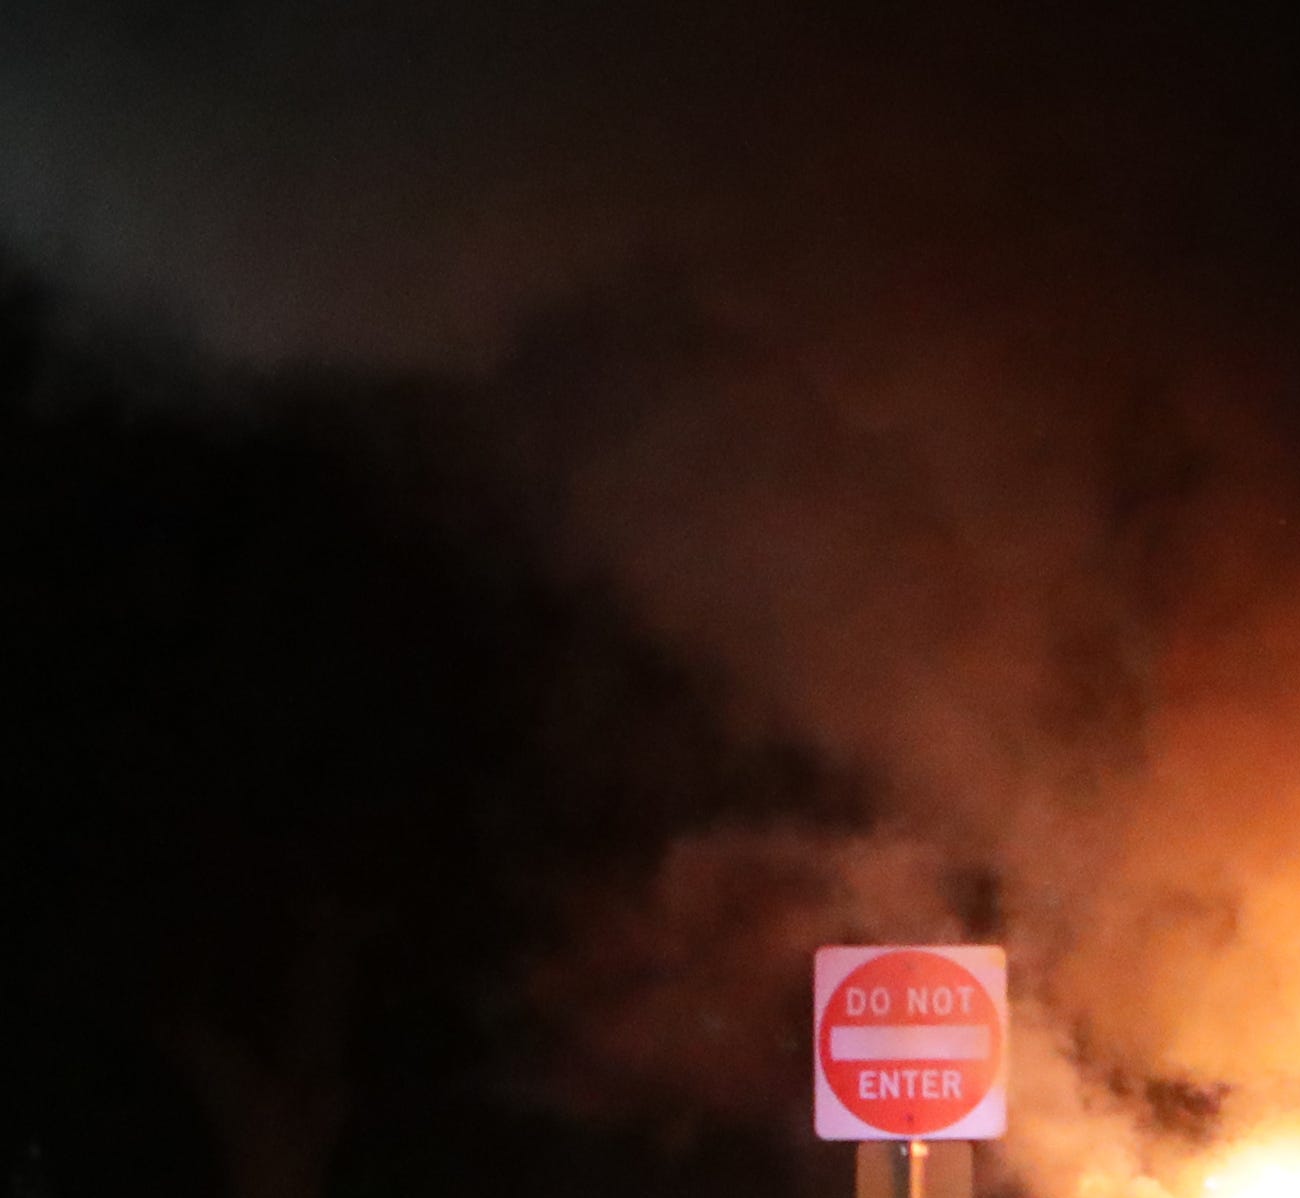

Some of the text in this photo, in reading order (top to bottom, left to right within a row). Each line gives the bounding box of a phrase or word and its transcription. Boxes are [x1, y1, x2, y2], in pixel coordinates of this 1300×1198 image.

[845, 986, 975, 1016] DO NOT
[857, 1070, 963, 1100] ENTER
